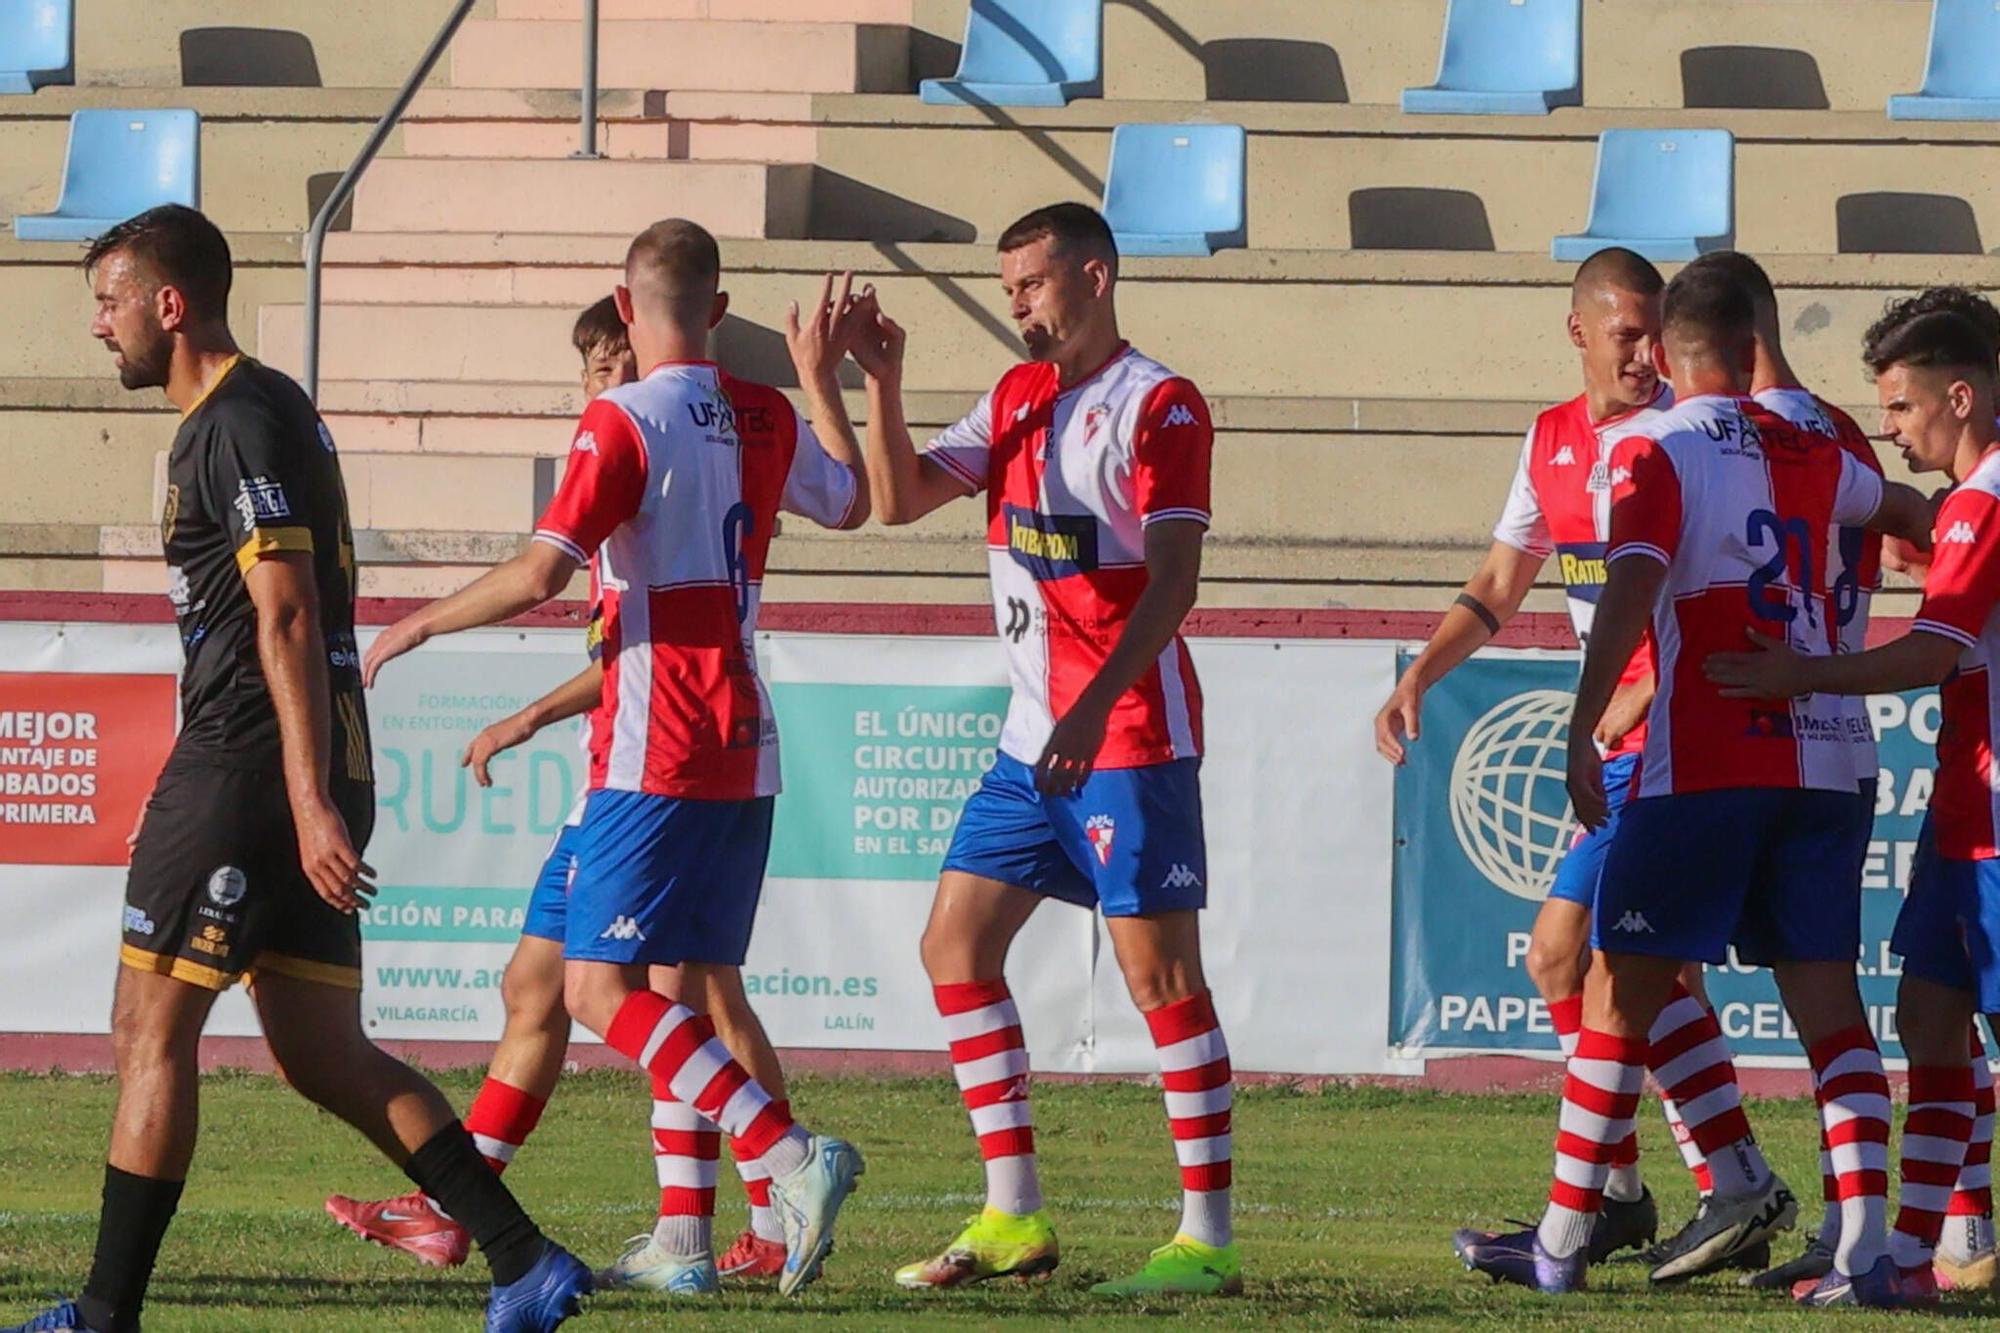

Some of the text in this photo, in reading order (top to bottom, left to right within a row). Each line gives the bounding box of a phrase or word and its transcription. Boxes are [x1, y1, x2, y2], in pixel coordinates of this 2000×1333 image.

[417, 693, 521, 710] FORMACIÓN
[381, 714, 404, 730] EN
[855, 704, 1000, 739] EL ÚNICO
[70, 749, 96, 766] DE
[854, 745, 997, 771] CIRCUITO
[0, 773, 96, 797] BADOS
[0, 803, 96, 824] RIMERA
[854, 806, 961, 832] POR D
[854, 836, 953, 855] EN EL SA
[453, 906, 524, 928] PARA
[377, 1004, 479, 1023] VILAGARCÍA
[824, 1013, 874, 1031] LALÍN
